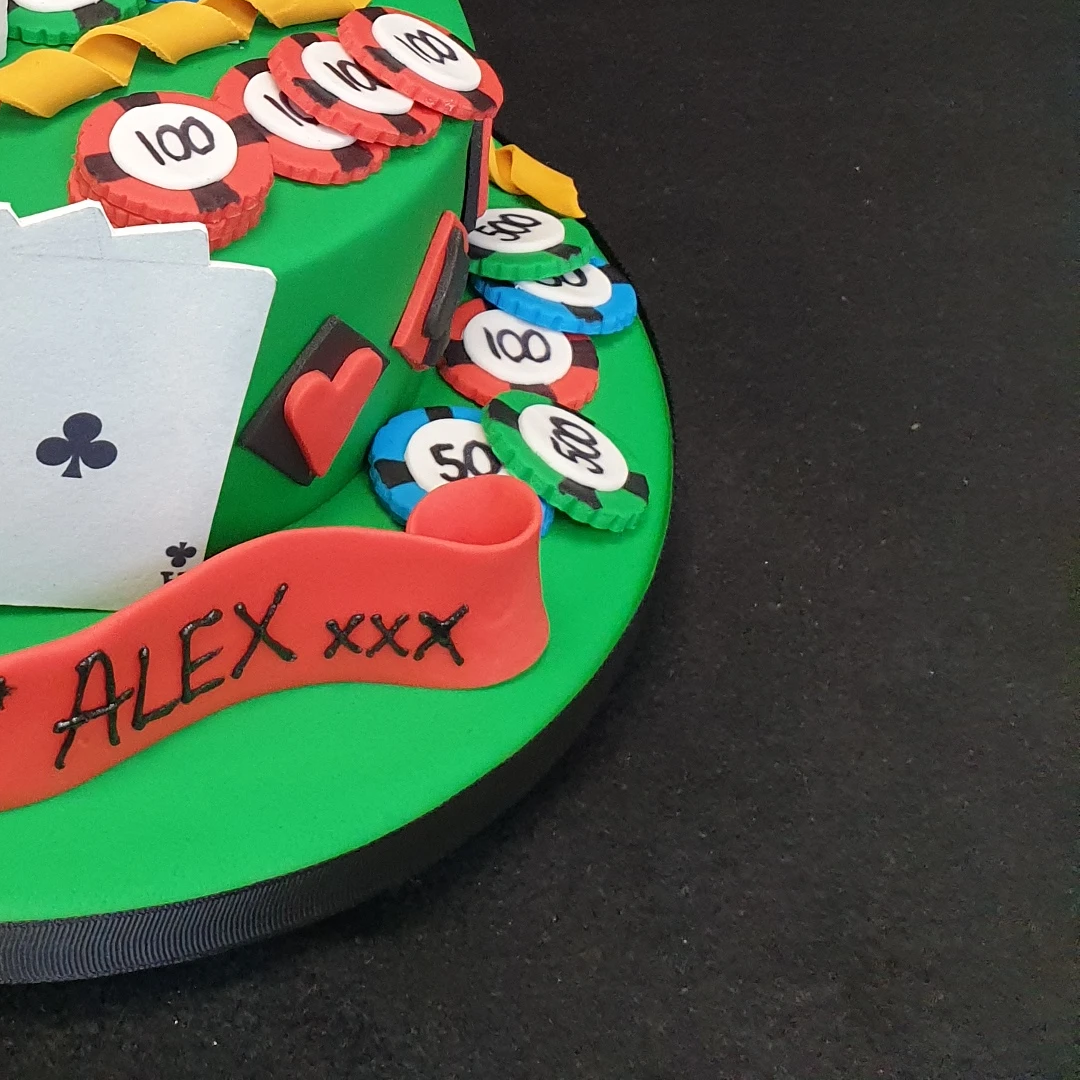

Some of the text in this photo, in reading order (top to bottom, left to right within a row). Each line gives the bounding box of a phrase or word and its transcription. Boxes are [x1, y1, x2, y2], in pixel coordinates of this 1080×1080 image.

[395, 29, 459, 65] 100
[135, 116, 216, 166] 100
[475, 213, 542, 242] 500
[482, 326, 552, 364] 100
[429, 440, 503, 482] 50
[549, 415, 605, 476] 500
[53, 582, 298, 770] ALEX
